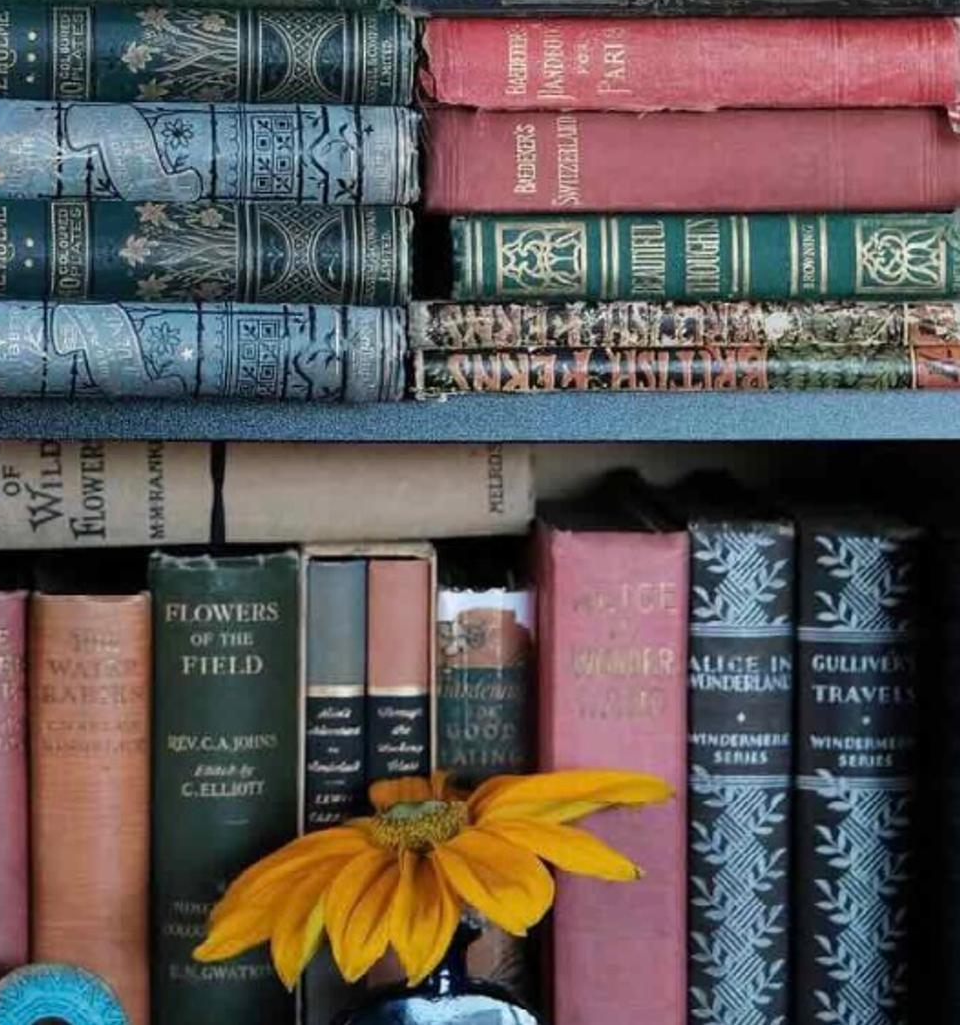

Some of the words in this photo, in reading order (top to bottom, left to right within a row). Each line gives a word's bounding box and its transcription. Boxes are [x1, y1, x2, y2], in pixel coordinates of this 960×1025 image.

[60, 14, 71, 80] COLOURED
[71, 12, 84, 81] PLATES
[597, 27, 632, 95] PARIS
[513, 123, 537, 194] BAEDEKER'S
[551, 114, 581, 207] SWITZERLAND
[59, 207, 69, 276] COLOURED
[70, 207, 82, 277] PLATES
[631, 220, 666, 297] BEAUTIFUL
[684, 218, 720, 296] THOUGHTS
[800, 222, 816, 290] BROWNING
[448, 347, 592, 391] FERNS
[606, 347, 768, 389] BRITISH
[2, 464, 21, 497] OF
[25, 441, 63, 533] WILD
[67, 441, 106, 542] FLOWER
[488, 446, 504, 514] MELROS
[165, 603, 280, 623] FLOWERS
[190, 631, 216, 647] OF
[220, 631, 254, 647] THE
[181, 654, 264, 676] FIELD
[689, 673, 791, 692] WONDERLAND
[690, 655, 758, 672] ALICE
[770, 655, 792, 673] IN
[812, 653, 912, 673] GULLIVER
[231, 734, 279, 754] JOHNS
[689, 732, 790, 749] WINDERMERE
[713, 749, 768, 765] SERIES
[810, 735, 913, 751] WINDERME
[837, 753, 894, 768] SERIES
